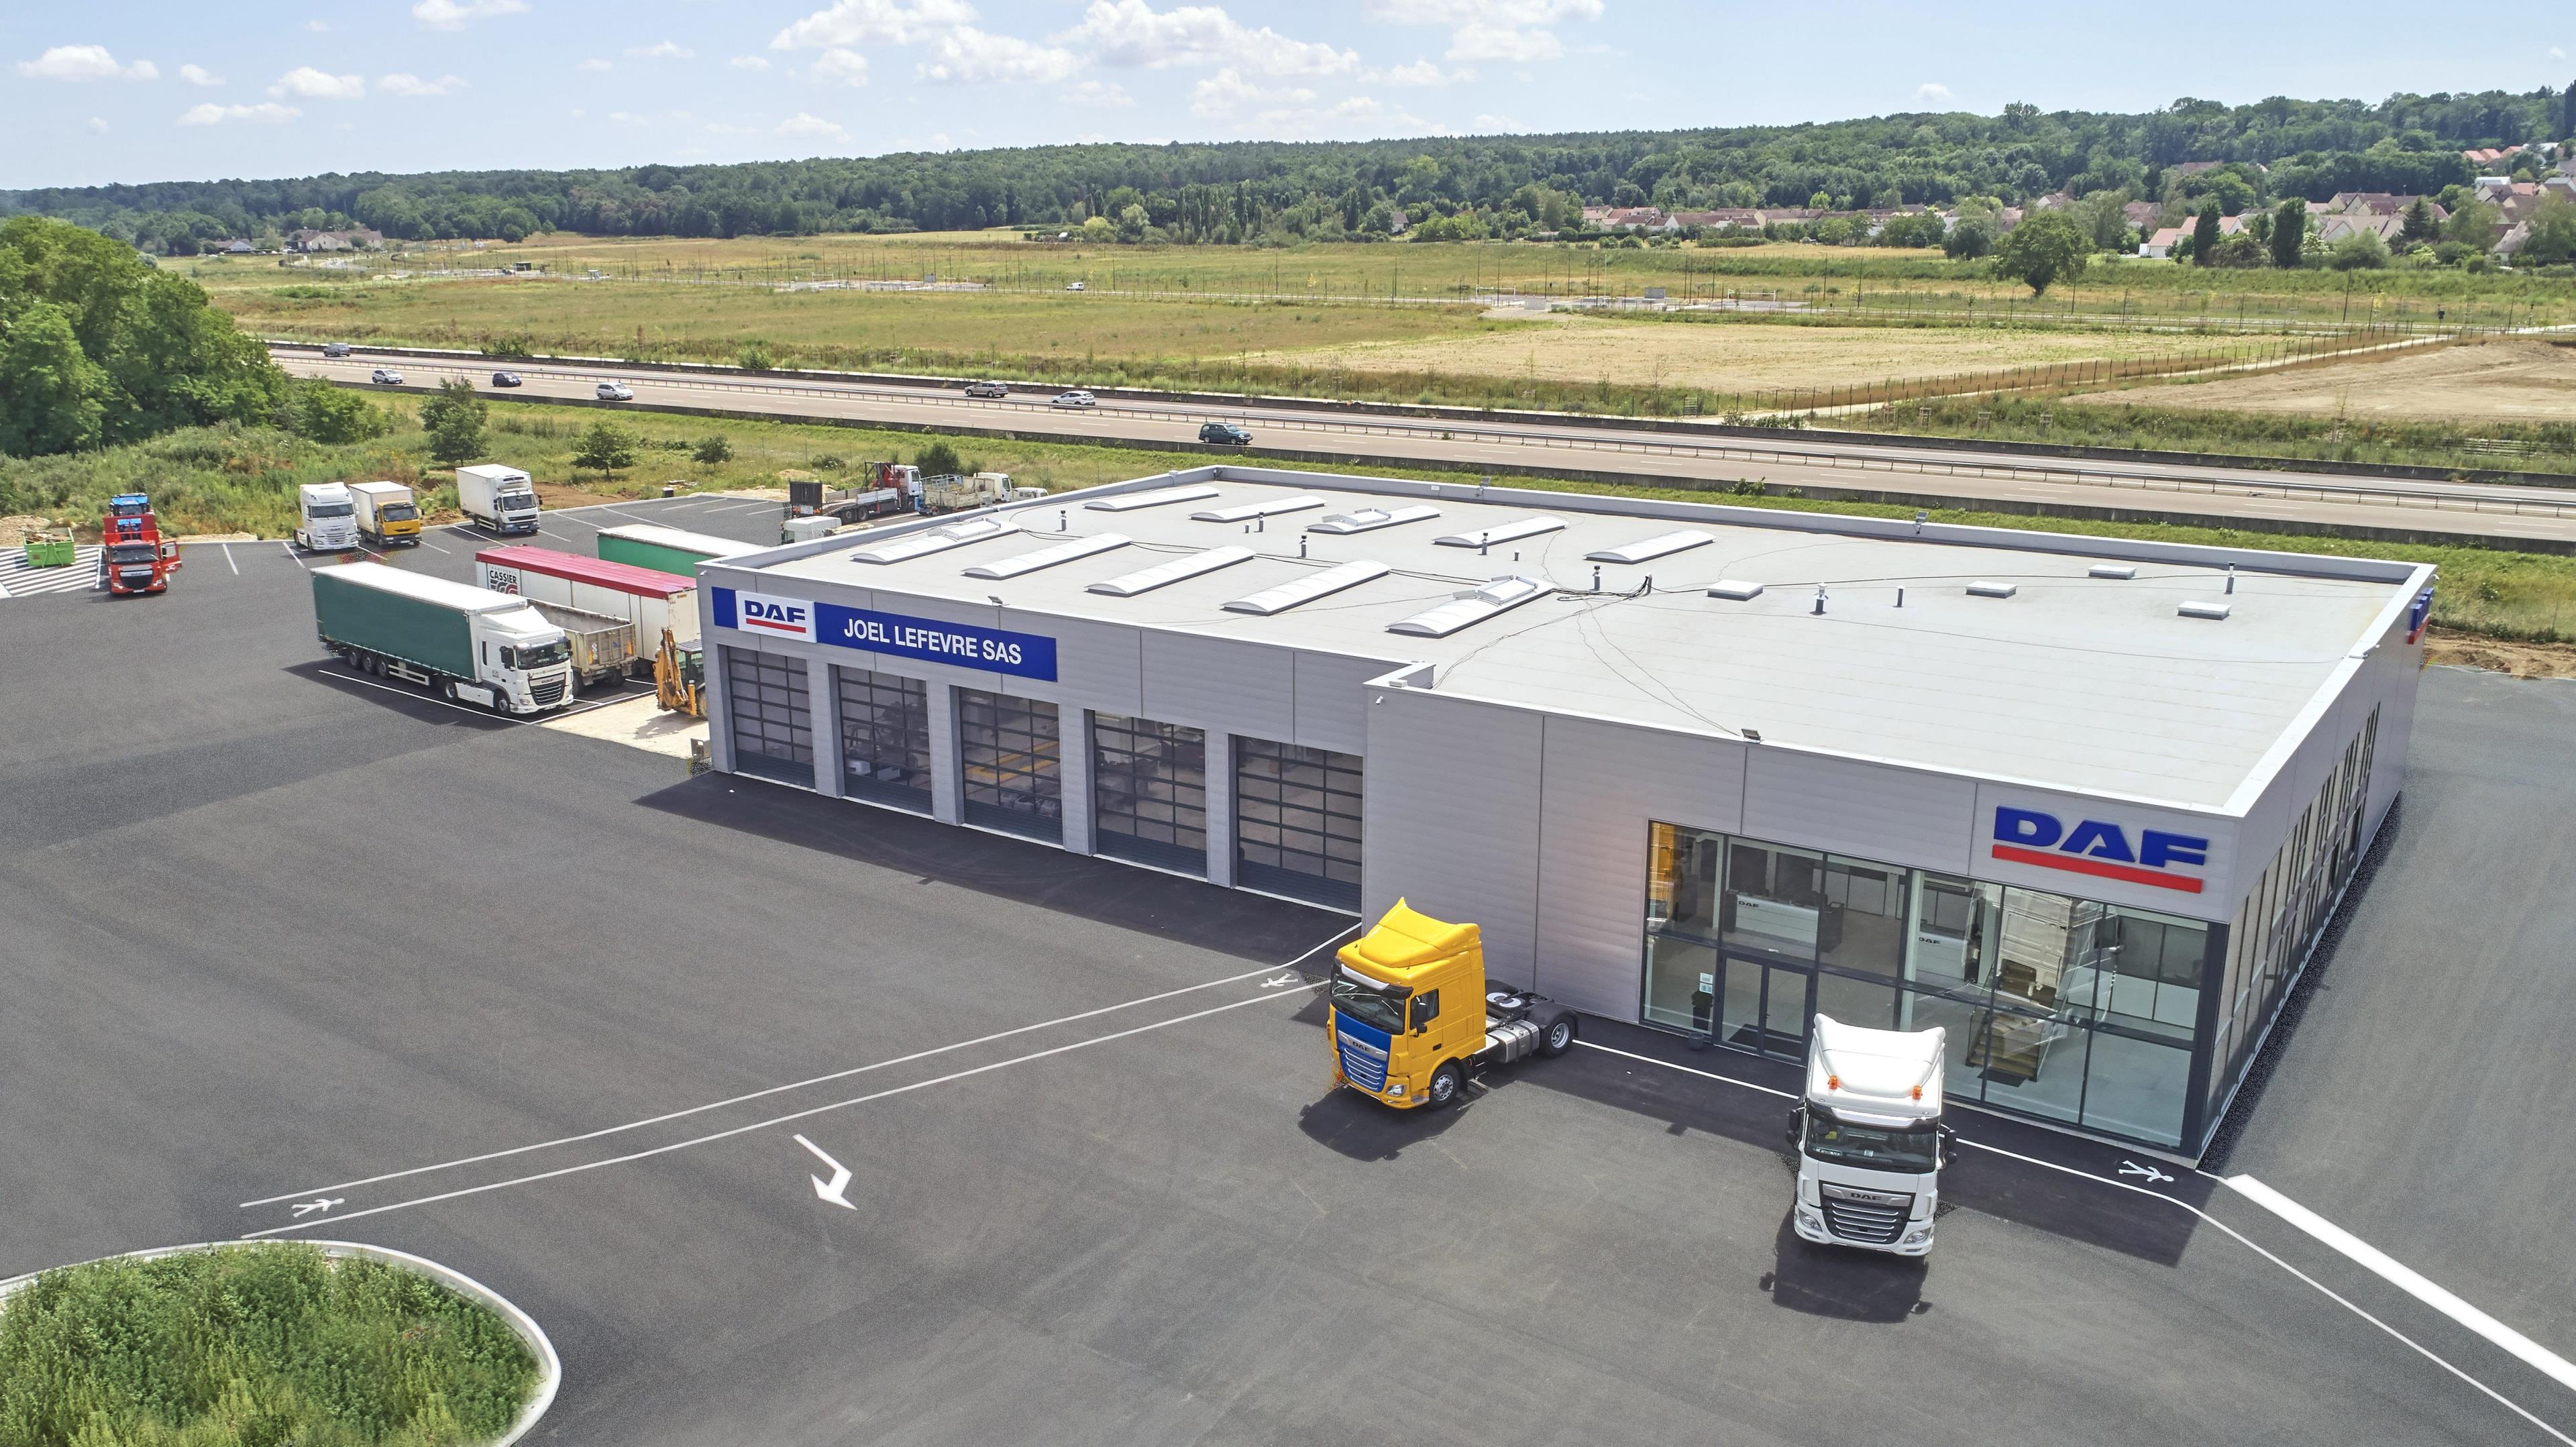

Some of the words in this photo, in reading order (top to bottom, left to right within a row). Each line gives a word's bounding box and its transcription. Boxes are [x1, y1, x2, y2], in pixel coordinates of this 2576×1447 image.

[490, 570, 517, 584] CASSIER
[745, 600, 805, 623] DAF
[844, 619, 890, 644] JOEL
[895, 625, 978, 657] LEFEVRE
[983, 639, 1022, 665] SAS
[1994, 806, 2209, 867] DAF
[1352, 1040, 1371, 1053] DAF
[1851, 1193, 1882, 1201] DAF
